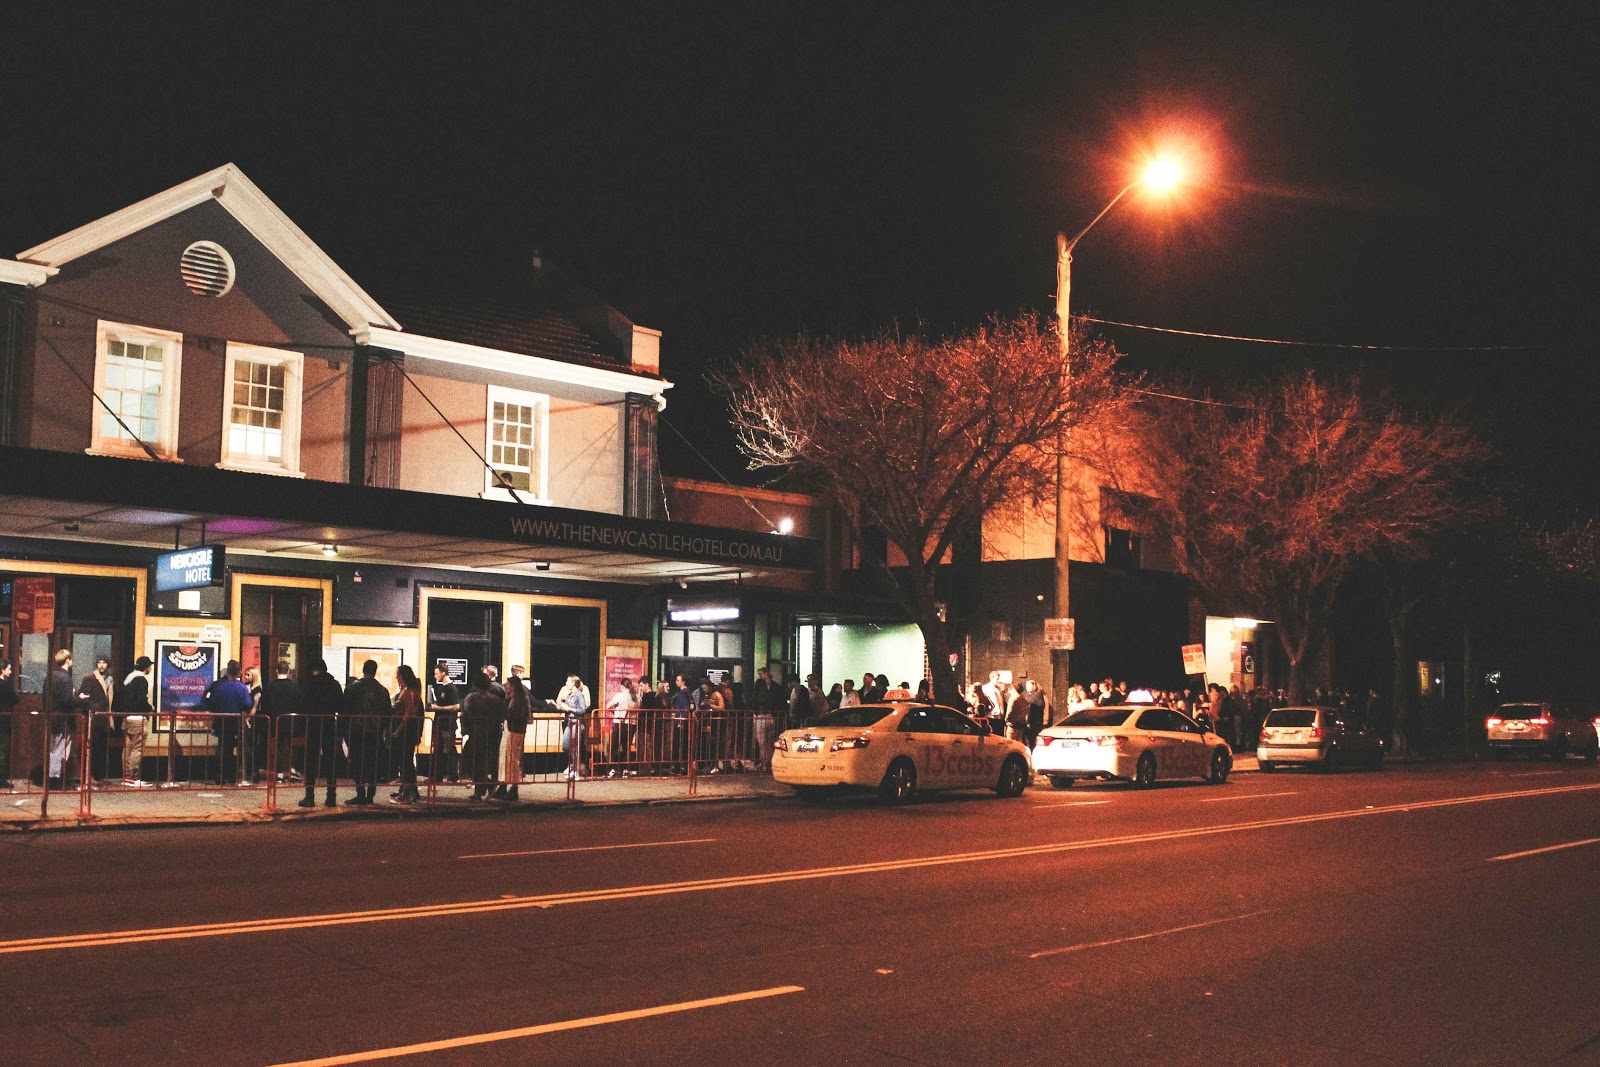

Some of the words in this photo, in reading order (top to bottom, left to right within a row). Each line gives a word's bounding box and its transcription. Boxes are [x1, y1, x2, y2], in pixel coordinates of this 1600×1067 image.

[511, 517, 783, 562] WWW.THENEWCASTLEHOTEL.COM.AU
[170, 549, 213, 570] NEWCASTLE
[185, 567, 212, 583] HOTEL
[169, 652, 207, 671] SATURDAY
[925, 745, 996, 776] 13cabs
